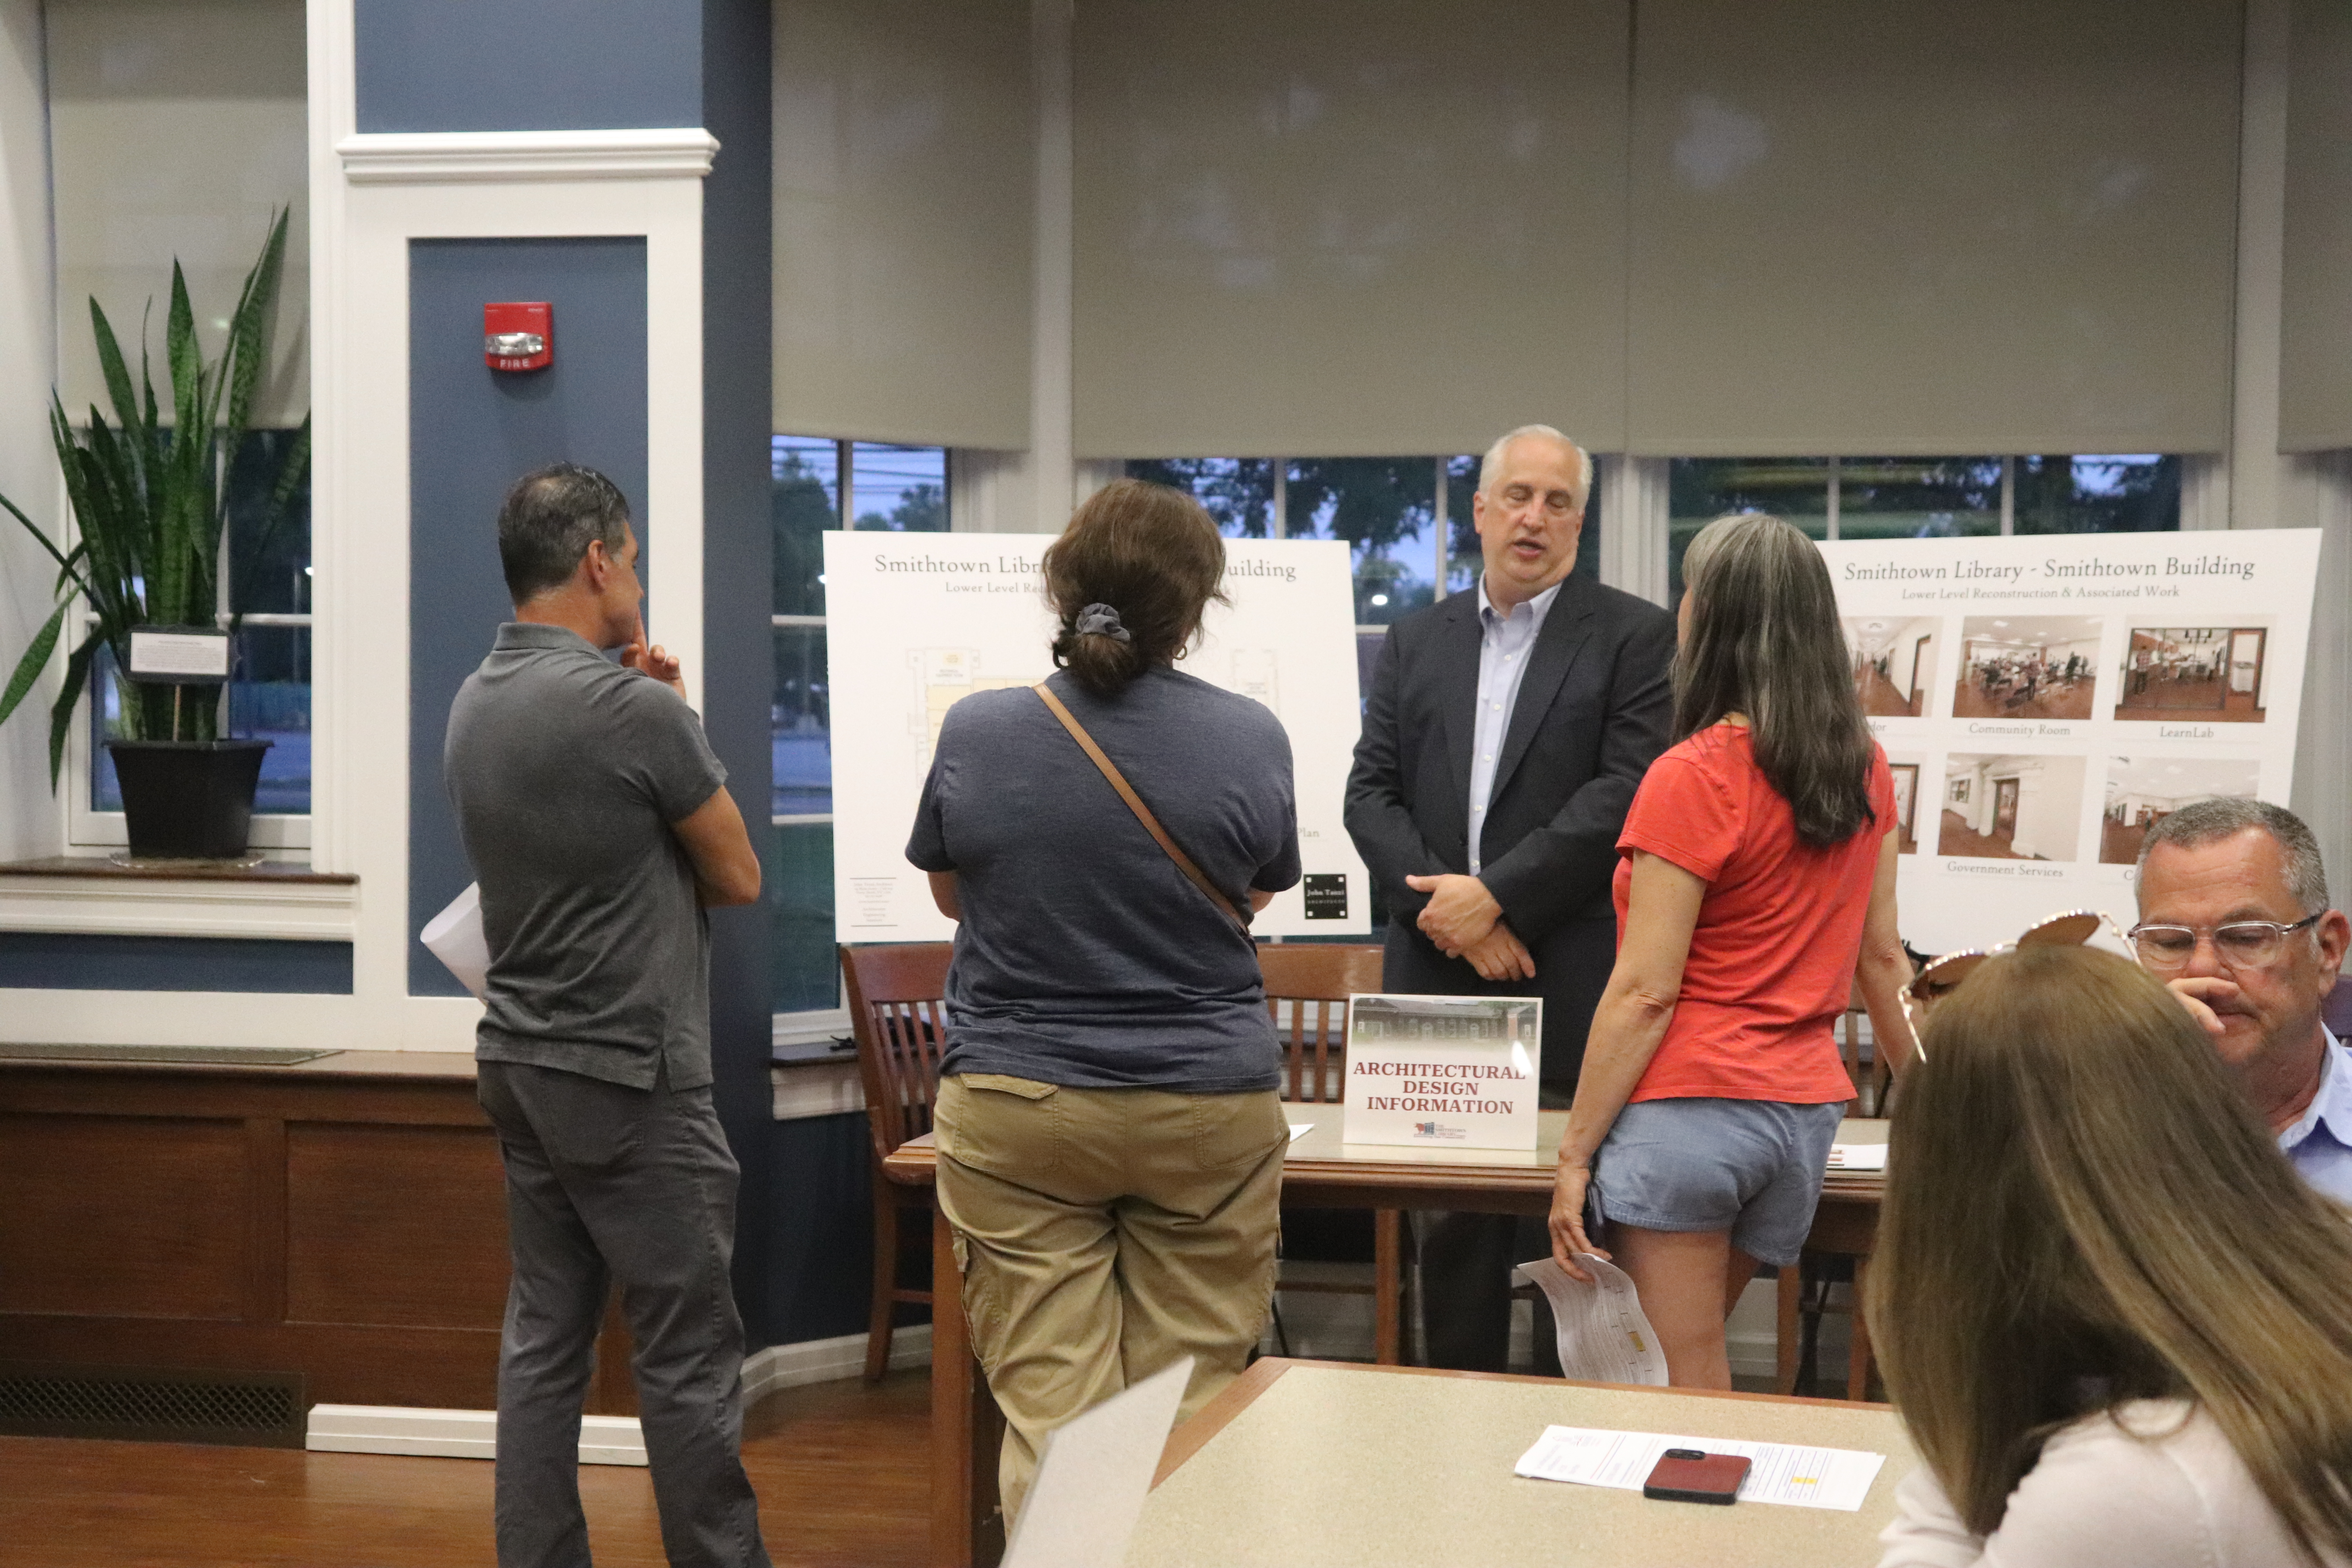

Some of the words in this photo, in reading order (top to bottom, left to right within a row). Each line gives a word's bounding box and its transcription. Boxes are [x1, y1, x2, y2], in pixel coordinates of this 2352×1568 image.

[500, 359, 530, 368] FIRE
[875, 554, 991, 572] Smithtown
[998, 556, 1039, 573] Libr
[1228, 559, 1296, 582] uilding
[1845, 561, 1947, 580] Smithtown
[1955, 560, 2024, 584] Library
[2044, 557, 2158, 577] Smithtown
[2165, 556, 2256, 581] Building
[946, 582, 983, 593] Lower
[987, 582, 1019, 593] Level
[1902, 588, 1936, 599] Lower
[1940, 588, 1969, 599] Level
[1973, 586, 2058, 599] Reconstruction
[2062, 586, 2071, 597] &
[2076, 585, 2140, 597] Associated
[2145, 585, 2180, 597] Work
[1969, 722, 2035, 738] Community
[2039, 724, 2071, 735] Room
[2160, 726, 2214, 738] LearnLab
[1947, 861, 2014, 875] Government
[2019, 864, 2064, 877] Services
[1353, 1062, 1526, 1080] ARCHITECTURAL
[1403, 1080, 1479, 1096] DESIGN
[1367, 1096, 1514, 1114] INFORMATION
